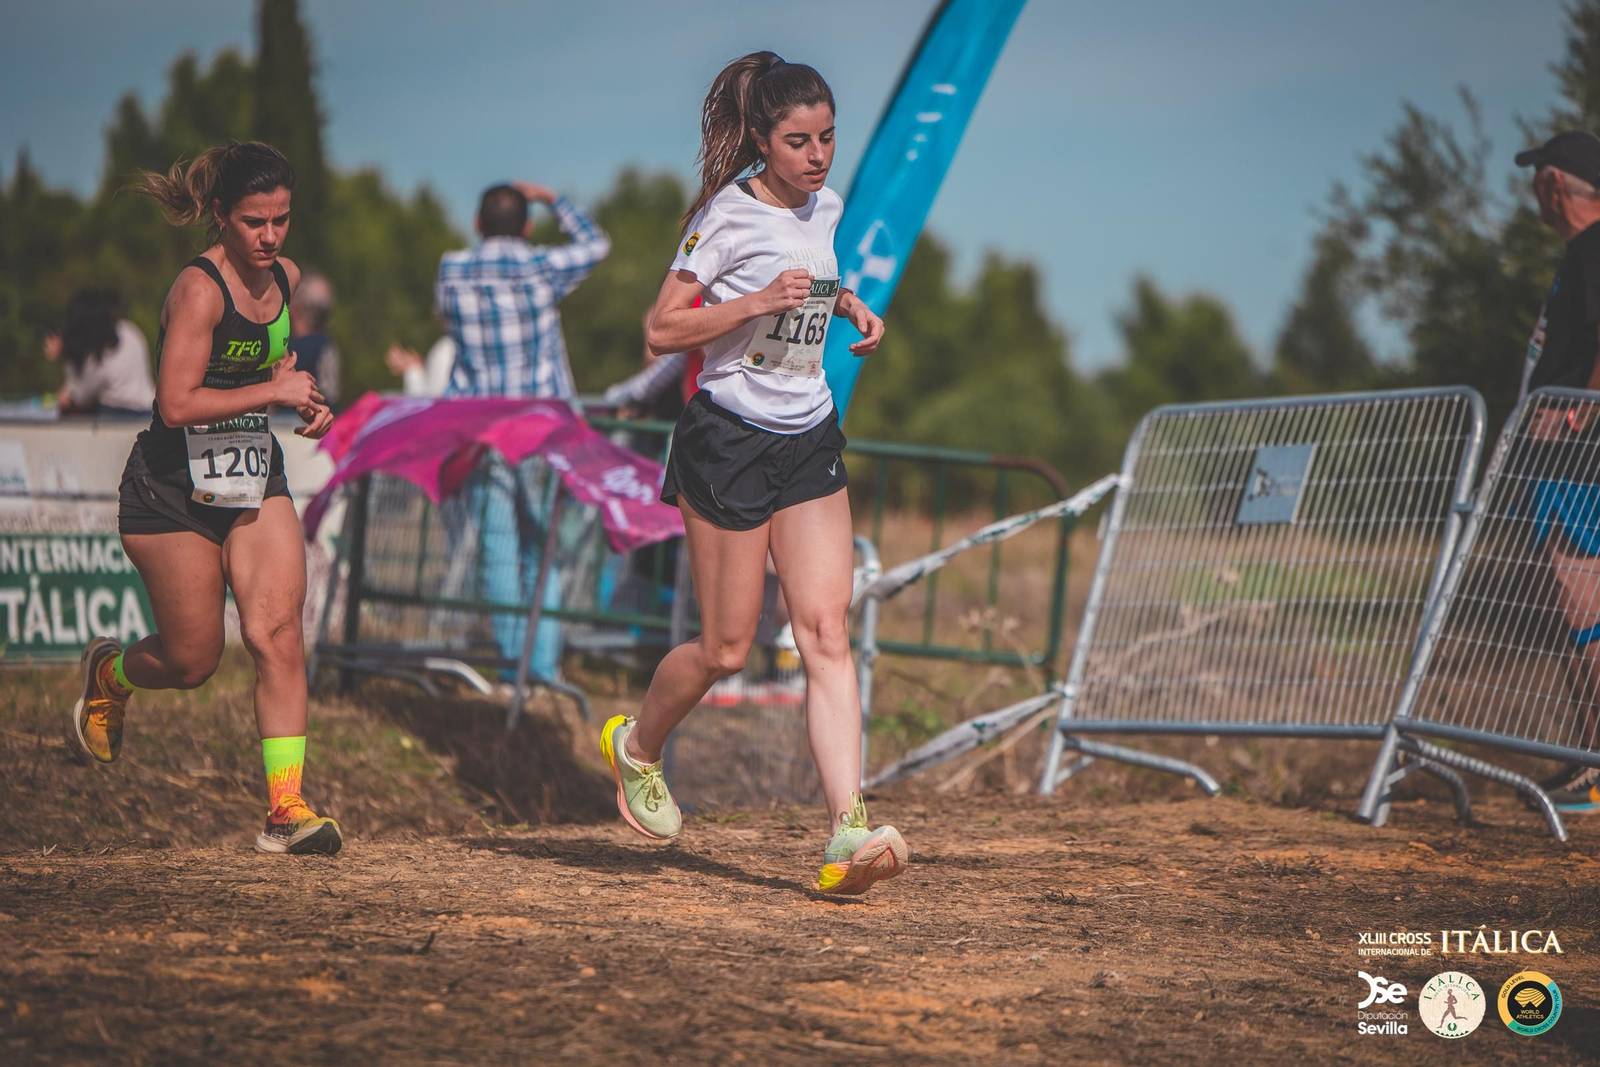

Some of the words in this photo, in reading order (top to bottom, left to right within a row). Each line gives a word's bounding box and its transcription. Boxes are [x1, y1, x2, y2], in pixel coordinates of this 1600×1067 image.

[810, 281, 830, 293] ÁLICA
[766, 312, 828, 346] 1163
[201, 446, 268, 479] 1205
[0, 538, 134, 575] NTERNACI
[0, 574, 149, 645] TÁLICA
